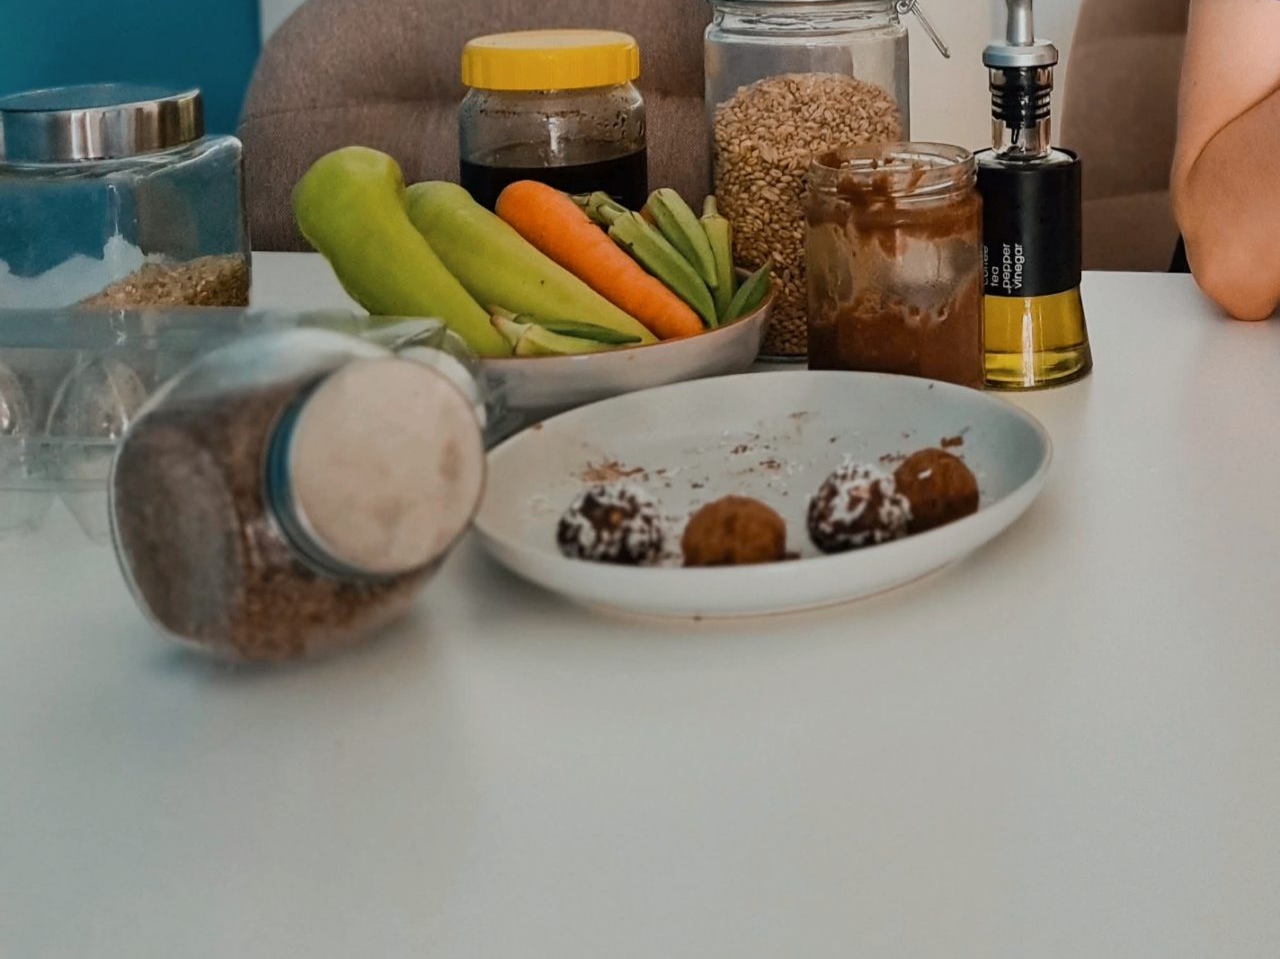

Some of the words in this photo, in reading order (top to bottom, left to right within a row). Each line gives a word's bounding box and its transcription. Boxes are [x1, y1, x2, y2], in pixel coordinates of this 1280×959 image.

[990, 266, 999, 287] tea
[1002, 243, 1013, 289] pepper
[1012, 243, 1025, 289] vinegar
